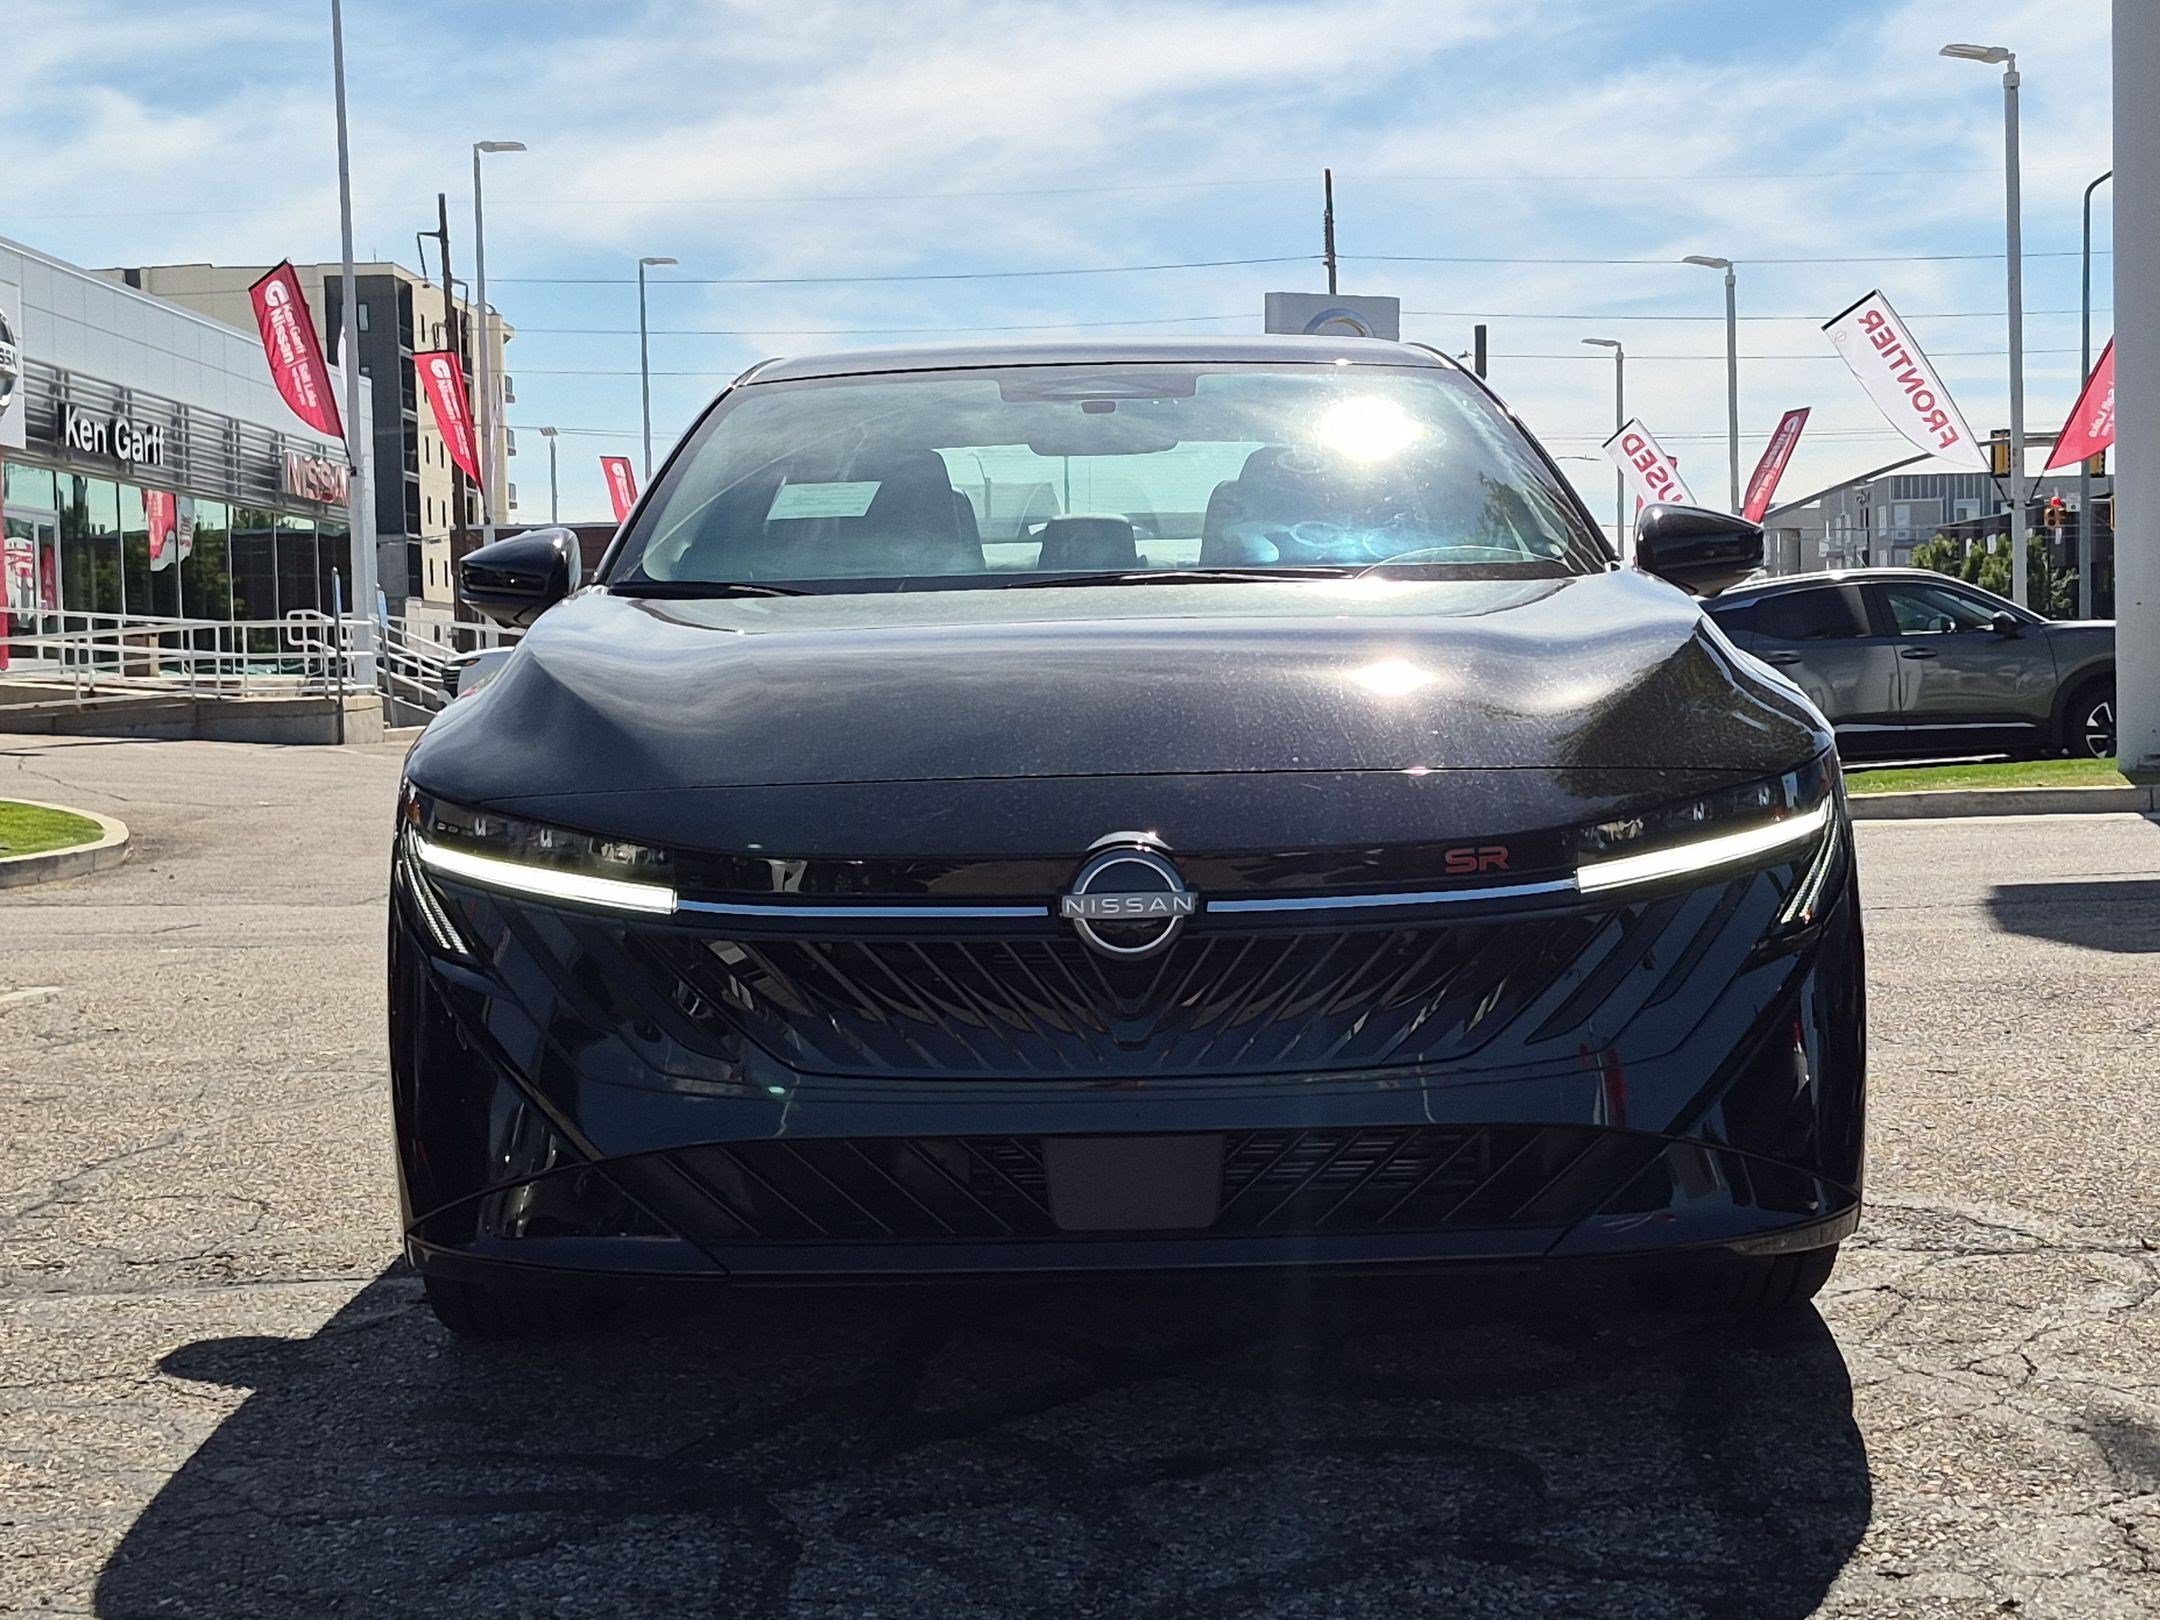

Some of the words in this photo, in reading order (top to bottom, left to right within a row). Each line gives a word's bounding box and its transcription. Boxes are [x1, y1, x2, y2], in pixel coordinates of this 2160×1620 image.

[269, 308, 295, 364] Nissan
[65, 404, 107, 454] Ken
[115, 416, 164, 466] Garff
[1445, 846, 1509, 873] SR
[1066, 896, 1192, 914] NISSAN
